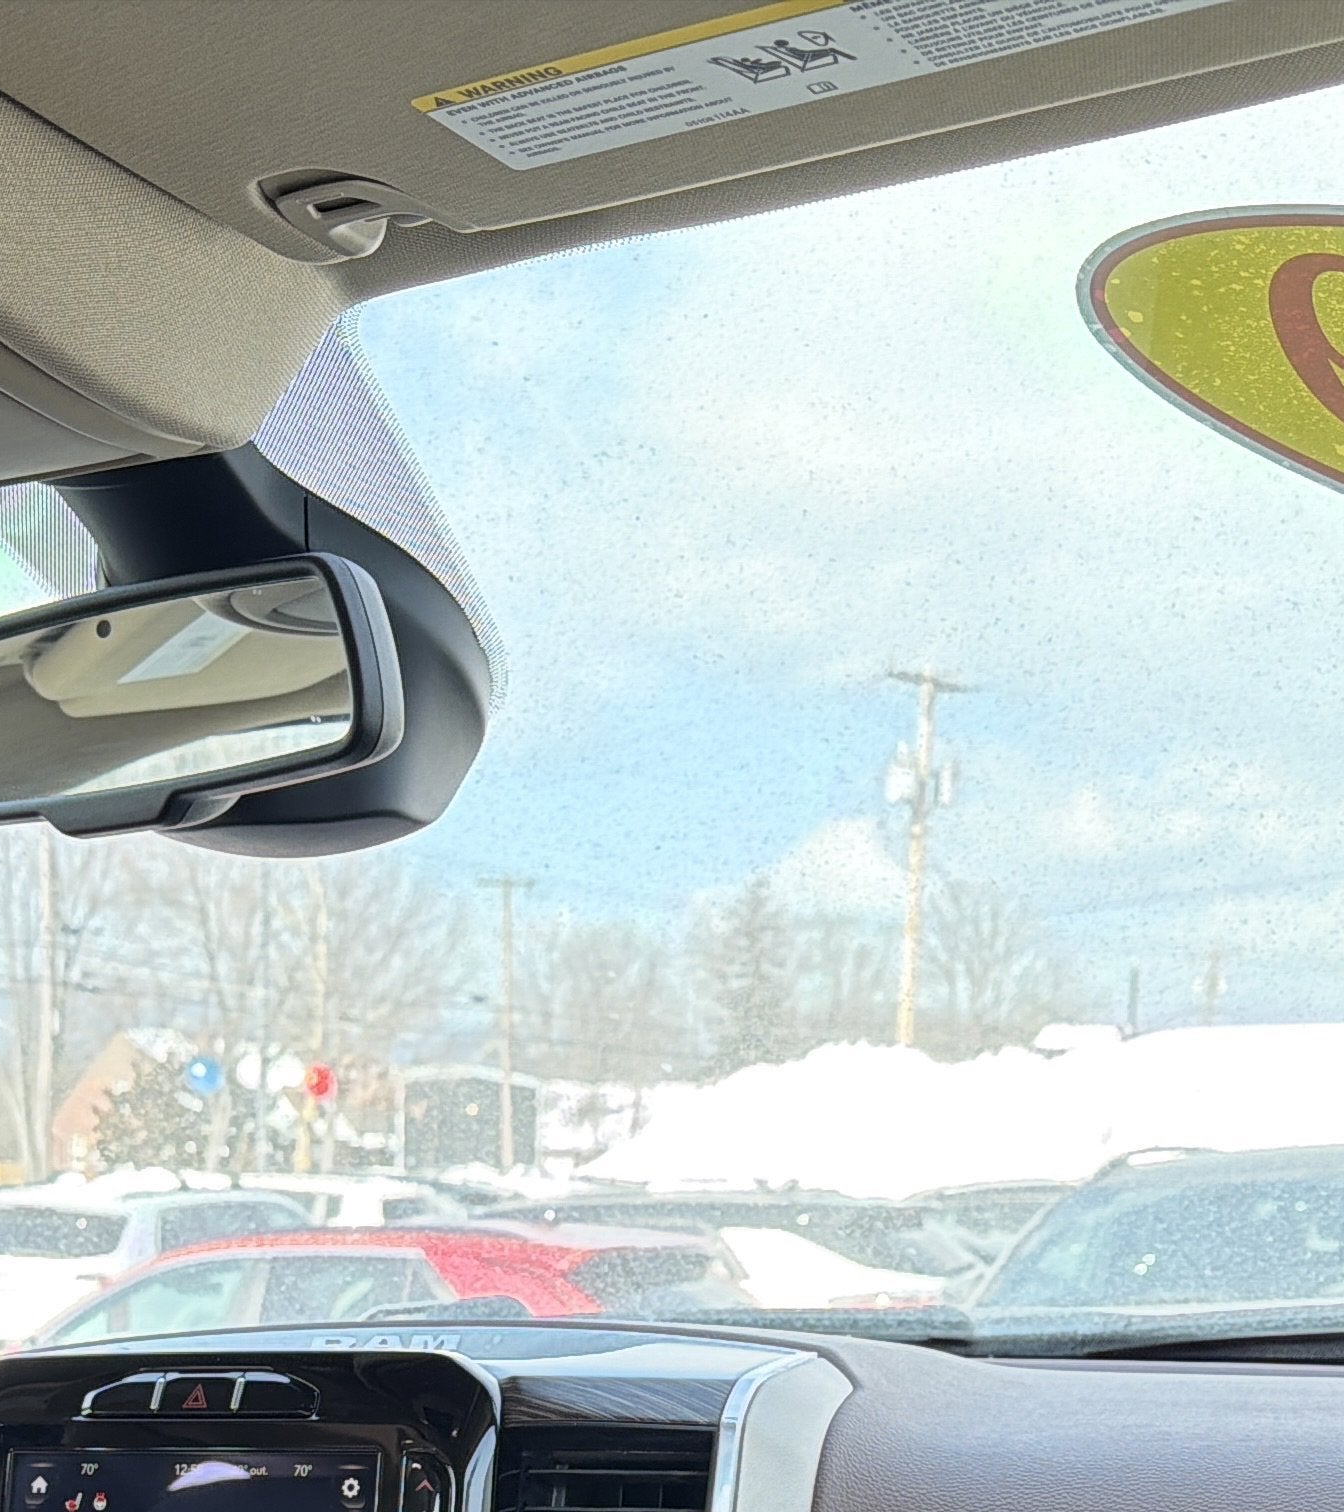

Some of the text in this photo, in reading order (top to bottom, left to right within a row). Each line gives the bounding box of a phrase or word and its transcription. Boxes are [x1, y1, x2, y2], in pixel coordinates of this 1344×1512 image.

[448, 64, 626, 116] EVEN WITH ADVANCED AIRBAGS
[458, 66, 563, 100] WARNING
[310, 1334, 461, 1350] RAM
[249, 1466, 269, 1476] out.
